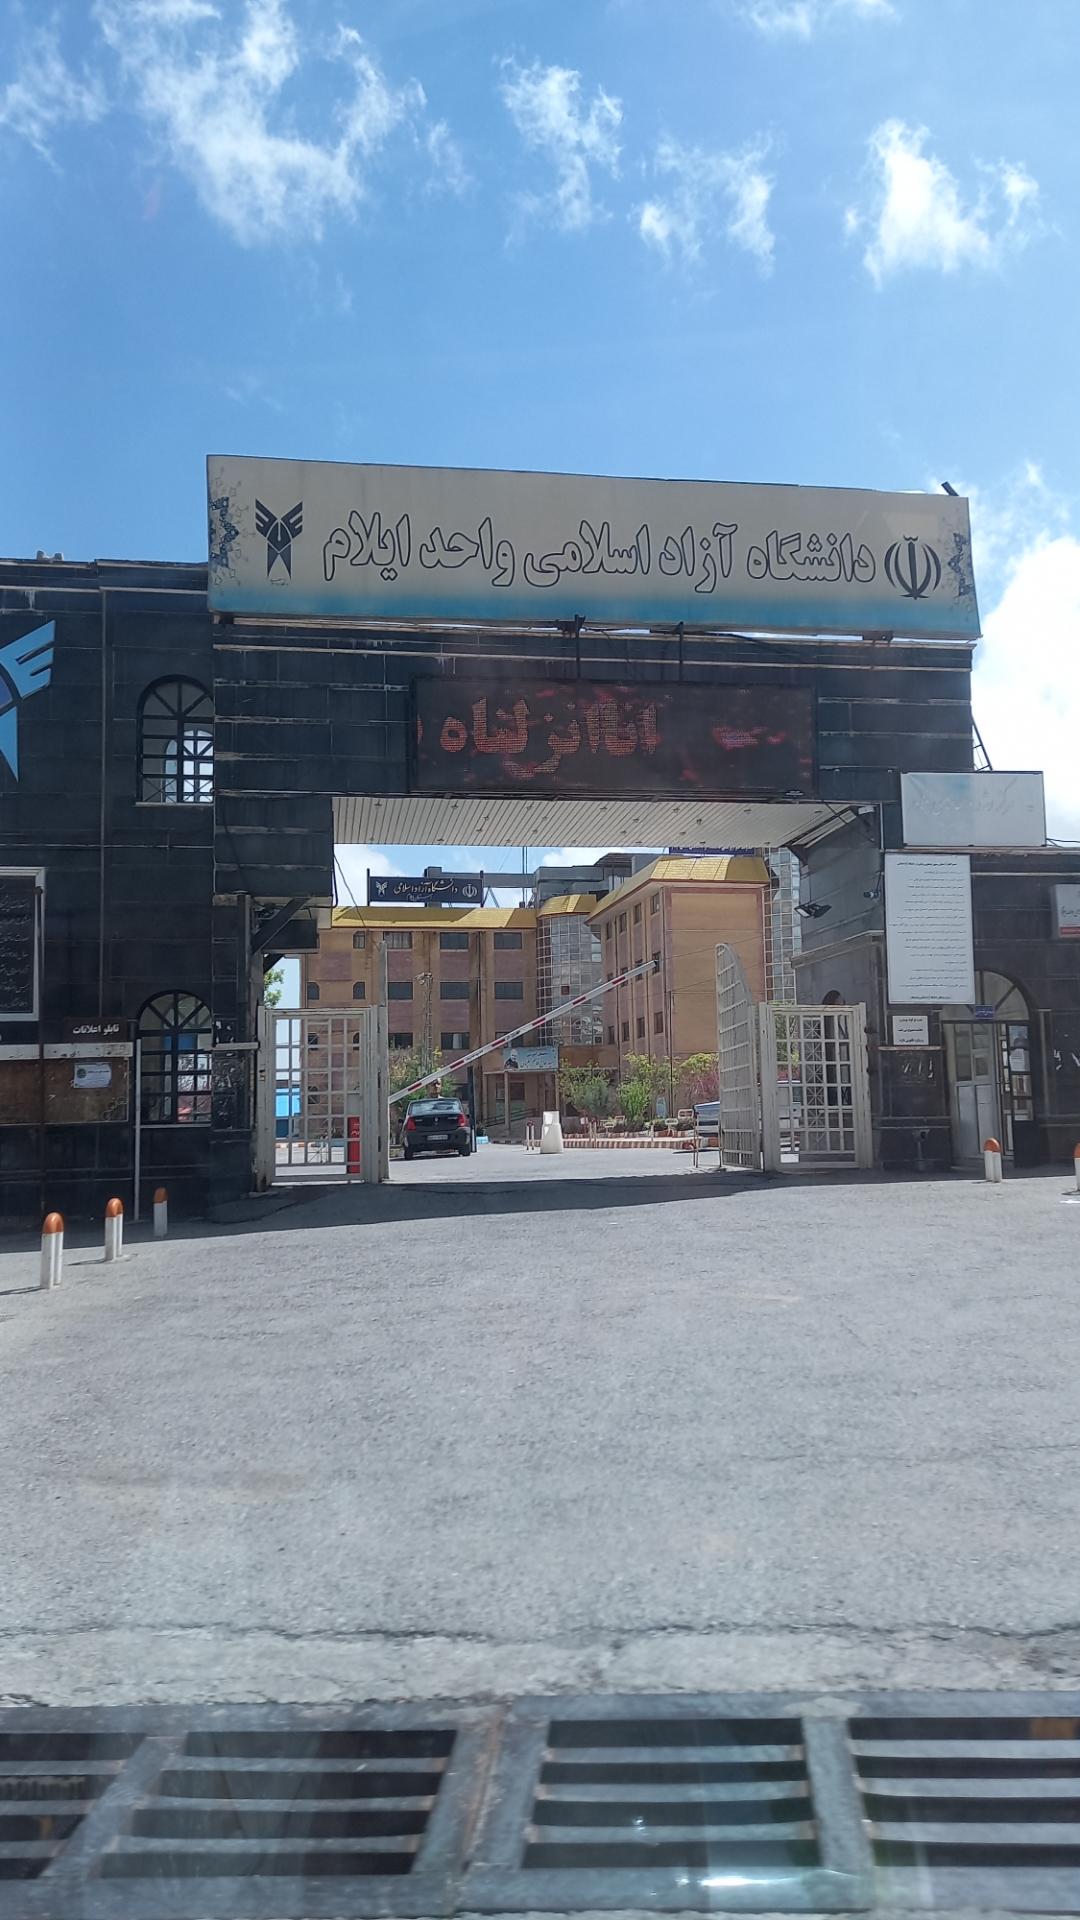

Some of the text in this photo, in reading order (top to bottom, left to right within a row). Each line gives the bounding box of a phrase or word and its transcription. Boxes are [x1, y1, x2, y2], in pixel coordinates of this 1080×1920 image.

[322, 510, 876, 593] دانشگاه آزاد اسلامی واحد ایلام
[414, 881, 432, 893] آزاد
[427, 878, 458, 893] دانشگاه
